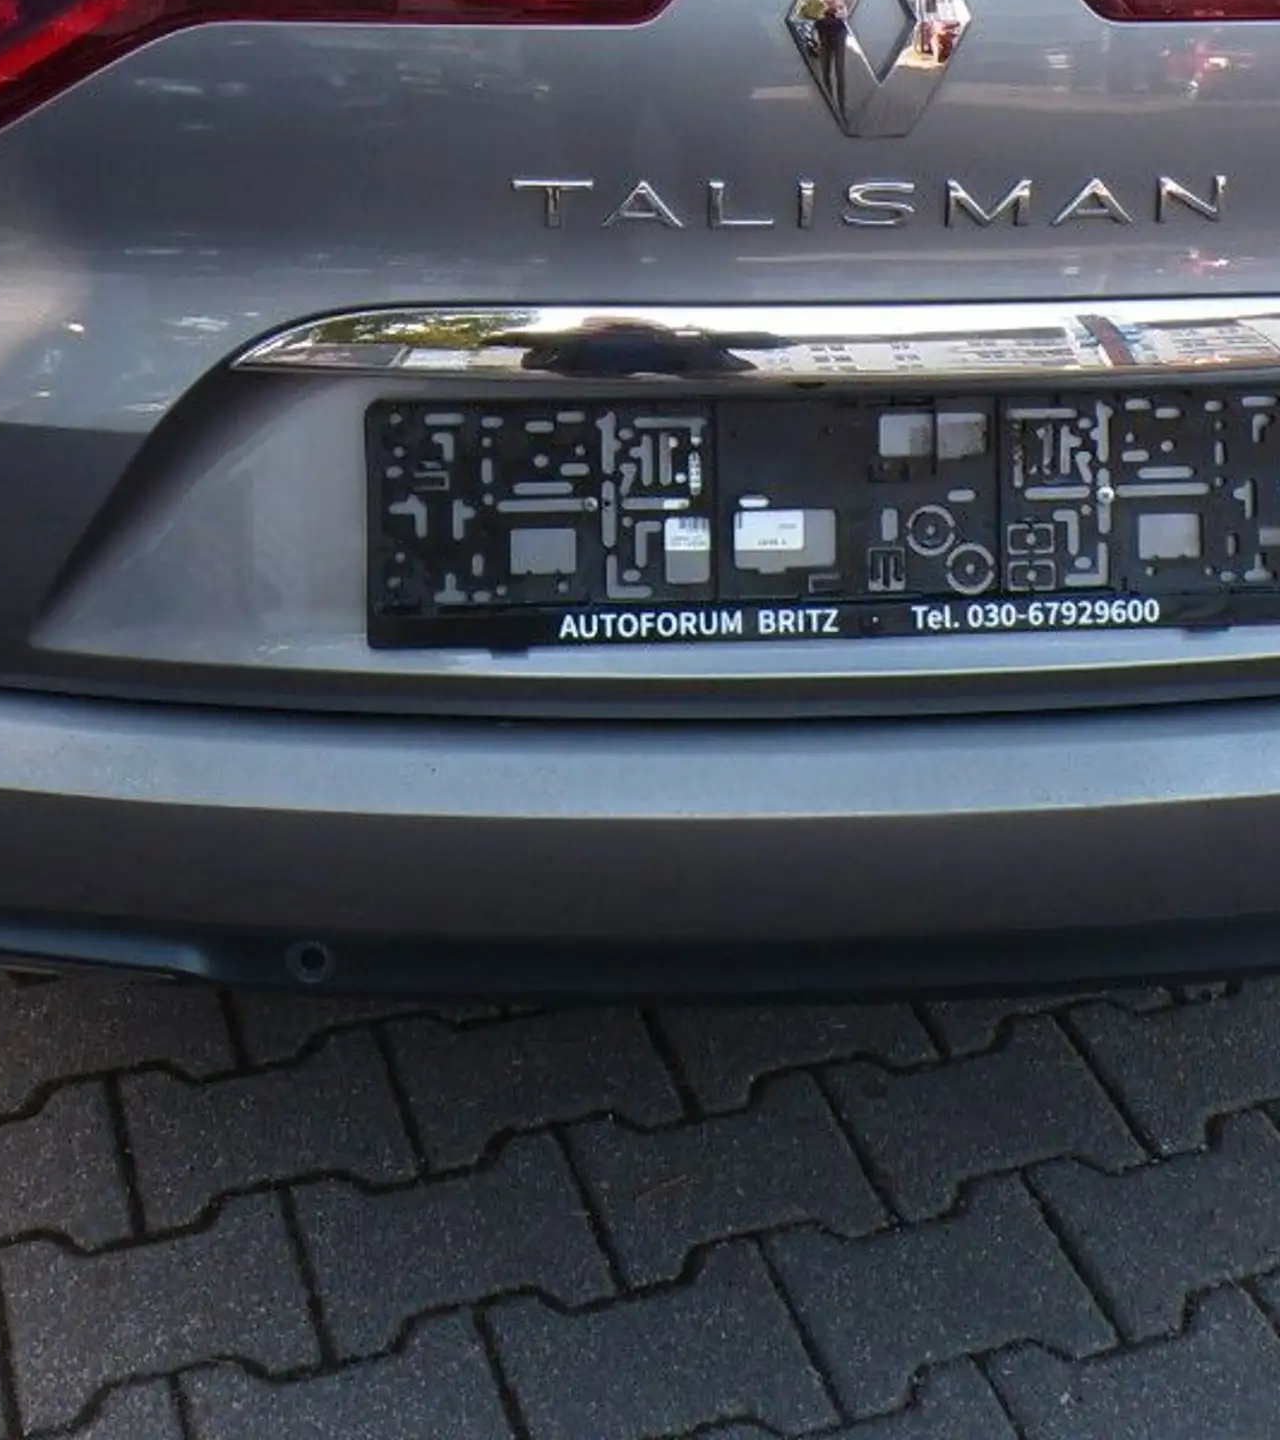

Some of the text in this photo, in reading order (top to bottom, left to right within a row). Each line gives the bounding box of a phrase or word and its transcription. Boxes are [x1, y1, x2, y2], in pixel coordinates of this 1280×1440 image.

[510, 174, 1227, 229] TALISMAN
[559, 598, 1160, 639] AUTOFORUM BRITZ Tel. 030-67929600
